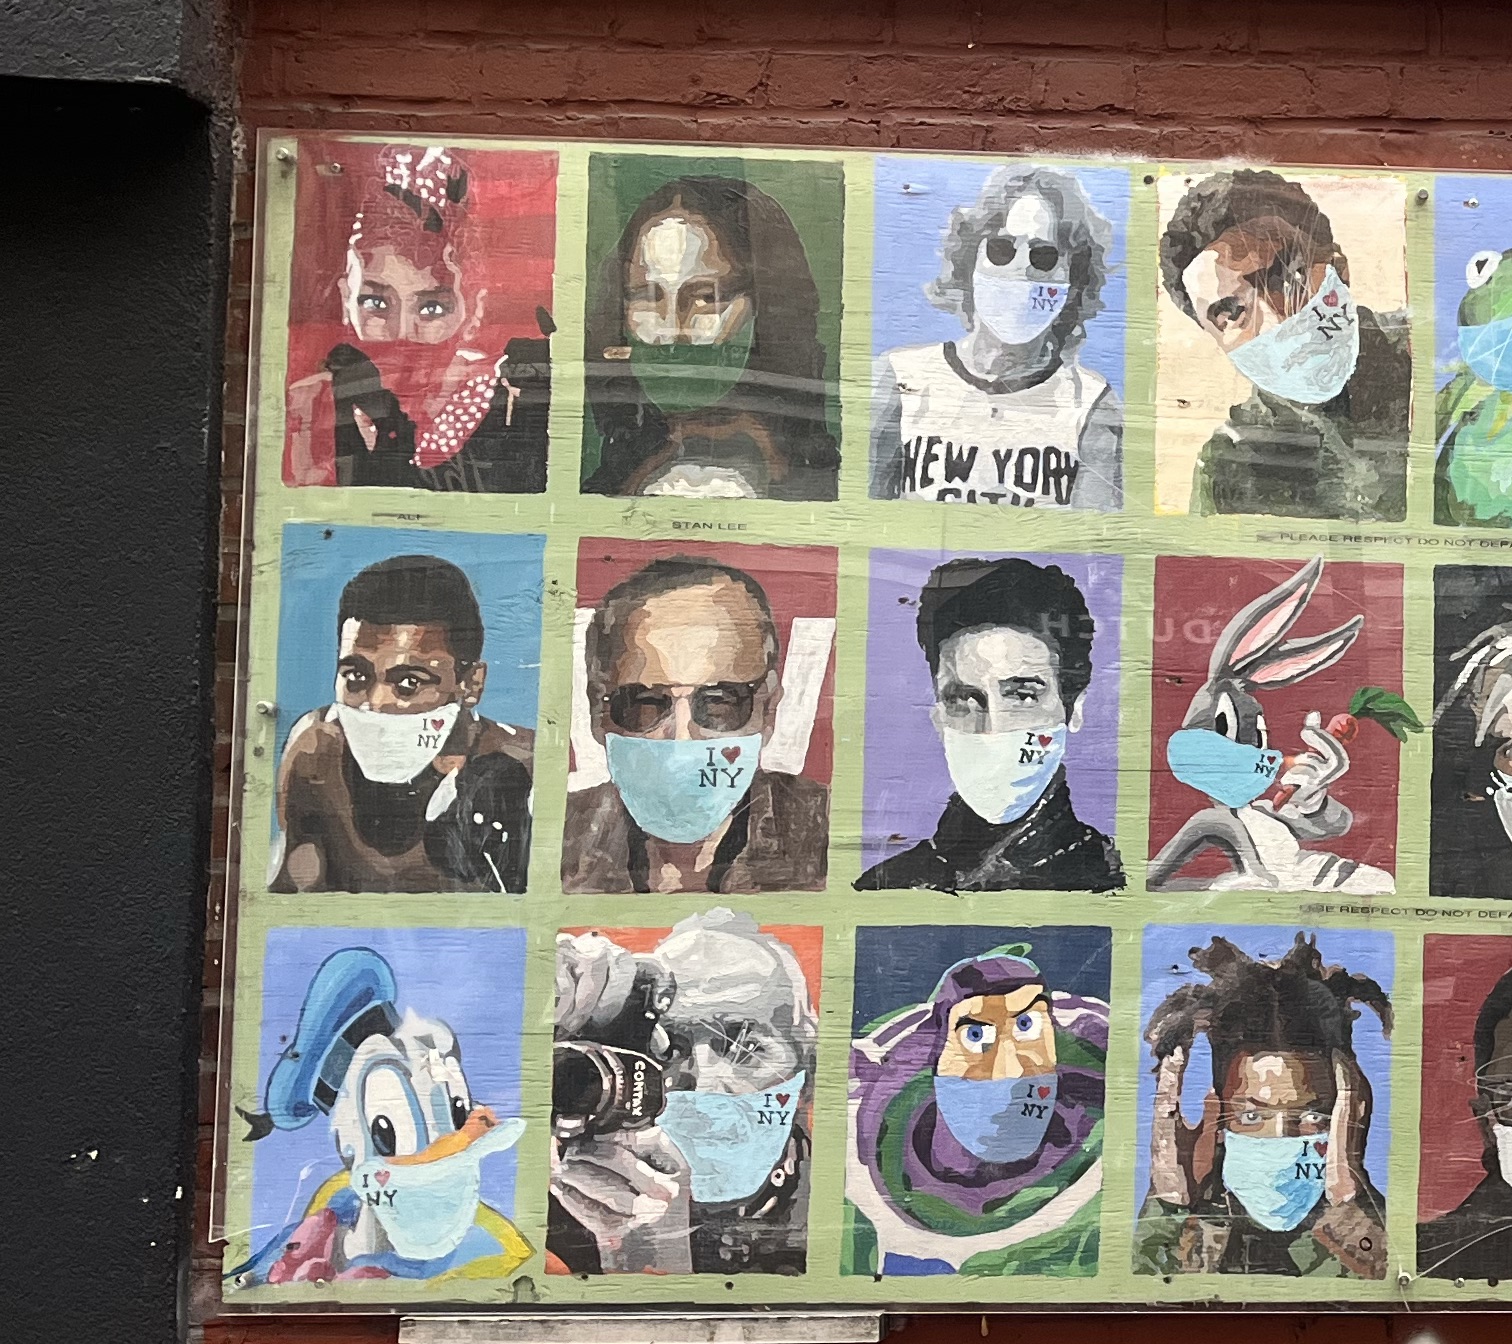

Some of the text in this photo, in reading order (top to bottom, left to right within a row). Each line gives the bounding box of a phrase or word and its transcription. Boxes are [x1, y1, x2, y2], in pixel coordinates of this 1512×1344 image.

[1038, 286, 1044, 297] I
[1032, 297, 1058, 312] NY
[1312, 305, 1325, 321] I
[1317, 303, 1354, 340] NY
[902, 436, 1080, 505] NEW YORK
[672, 521, 748, 531] STAN LEE
[1418, 538, 1440, 546] DO
[1444, 539, 1473, 547] NOT
[422, 718, 428, 731] I
[417, 734, 442, 749] NY
[1024, 732, 1036, 746] I
[705, 746, 716, 767] I
[1018, 748, 1051, 765] NY
[1259, 754, 1266, 763] I
[698, 767, 745, 788] NY
[1253, 763, 1276, 778] NY
[1340, 905, 1408, 915] RESPECT
[1415, 908, 1438, 916] DO
[1442, 910, 1473, 918] NOT
[1027, 1084, 1035, 1098] I
[764, 1093, 773, 1108] I
[757, 1110, 791, 1126] NY
[1020, 1102, 1050, 1120] NY
[1301, 1140, 1310, 1157] I
[1294, 1162, 1327, 1180] NY
[362, 1174, 369, 1188] I
[366, 1189, 398, 1207] NY
